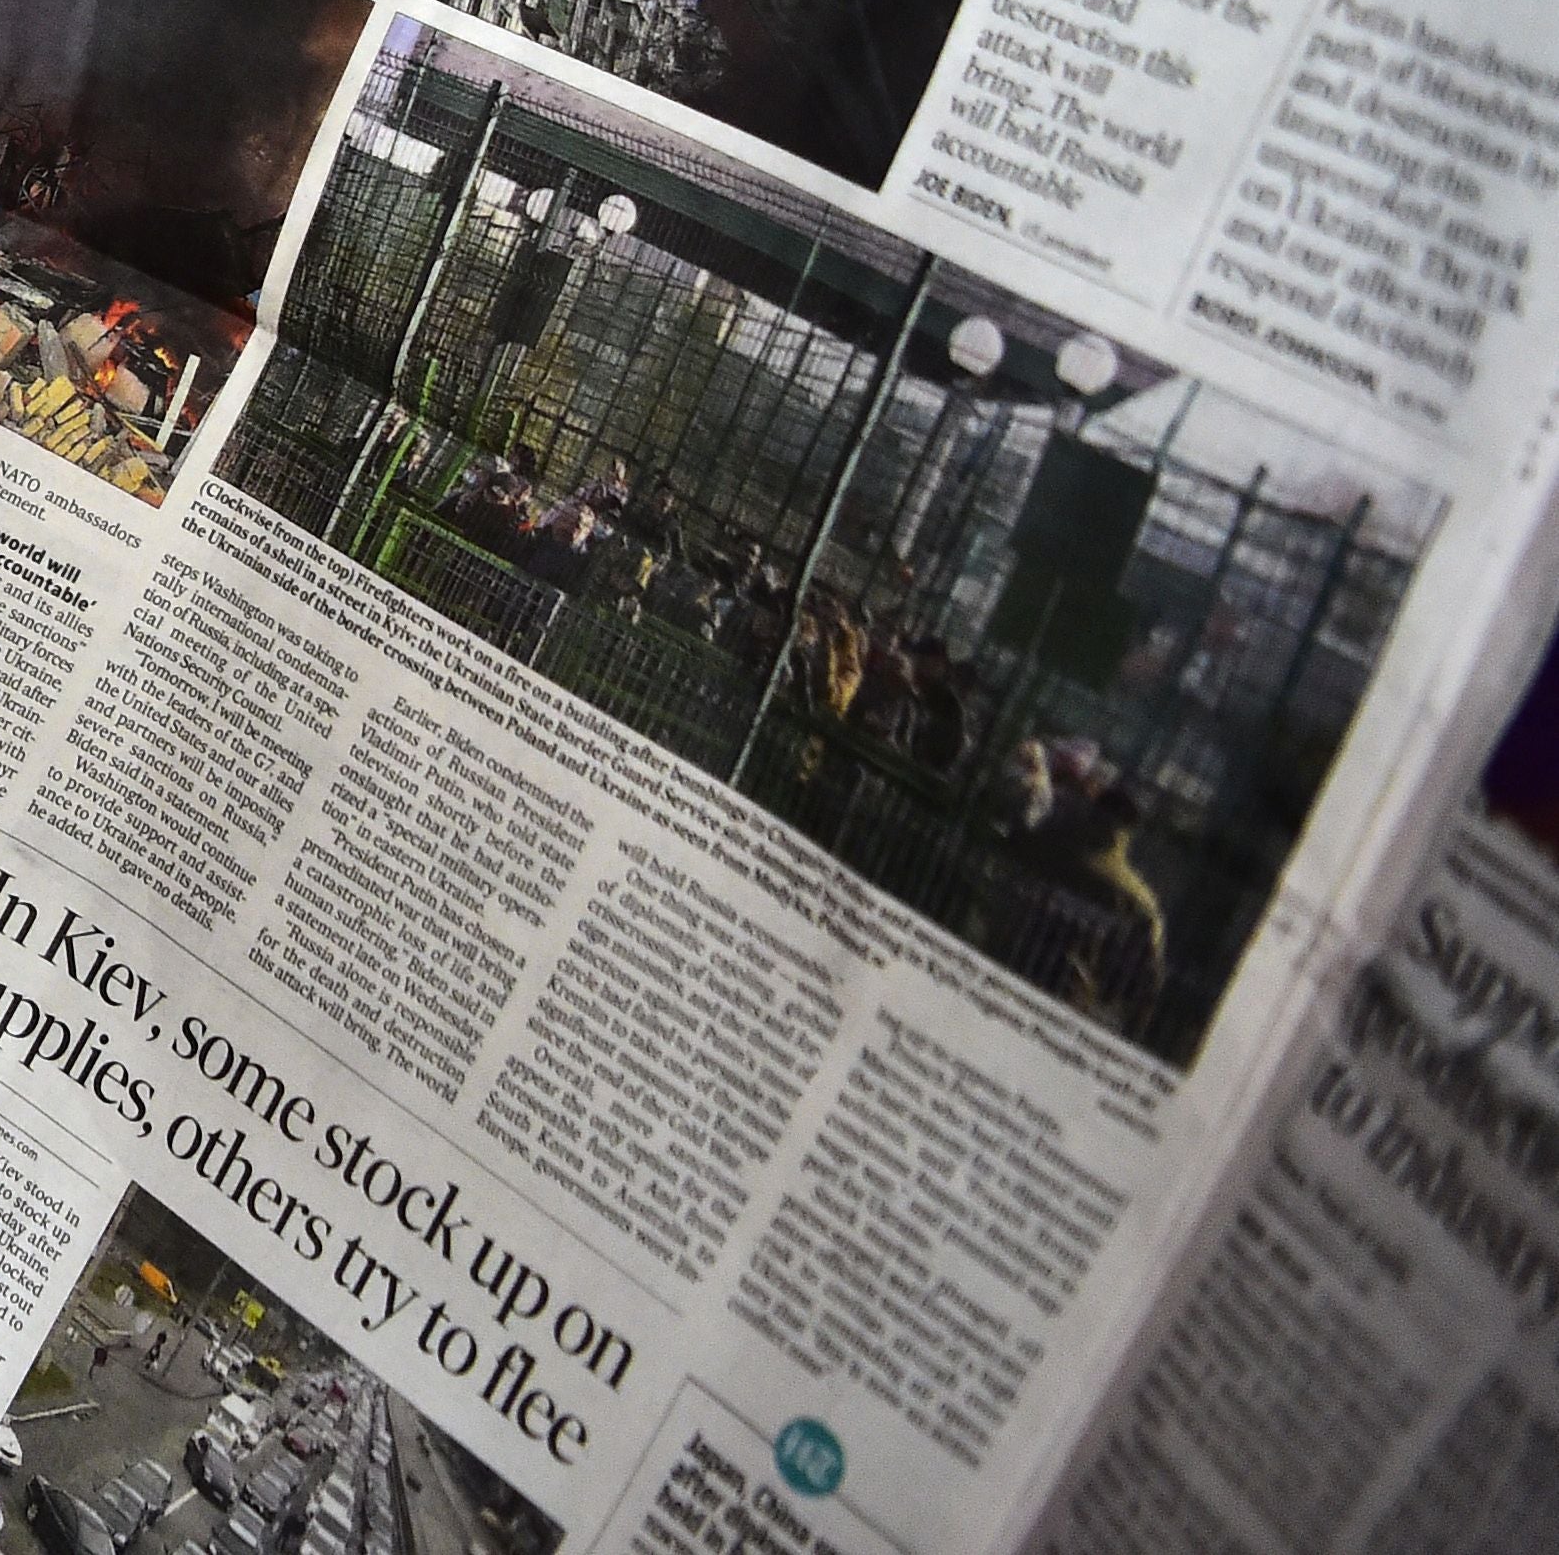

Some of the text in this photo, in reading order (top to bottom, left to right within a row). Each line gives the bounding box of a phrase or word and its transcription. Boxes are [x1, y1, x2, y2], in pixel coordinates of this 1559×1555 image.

[46, 557, 82, 584] will
[199, 479, 274, 532] (Clockwise
[271, 521, 305, 552] from
[304, 543, 328, 566] the
[326, 557, 356, 586] top)
[352, 572, 435, 632] Firefighters
[436, 624, 475, 657] work
[473, 649, 494, 670] on
[492, 662, 504, 676] a
[503, 665, 532, 692] fire
[531, 686, 552, 705] on
[551, 699, 563, 712] a
[23, 1180, 65, 1215] stood
[64, 1207, 81, 1229] in
[38, 908, 169, 1043] Kiev,
[171, 1016, 316, 1143] some
[314, 1123, 471, 1262] stock
[469, 1235, 550, 1325] up
[553, 1305, 633, 1390] on
[12, 1196, 52, 1231] stock
[51, 1224, 71, 1247] up
[166, 1114, 333, 1261] others
[334, 1235, 420, 1328] try
[417, 1301, 478, 1376] to
[480, 1343, 587, 1464] flee
